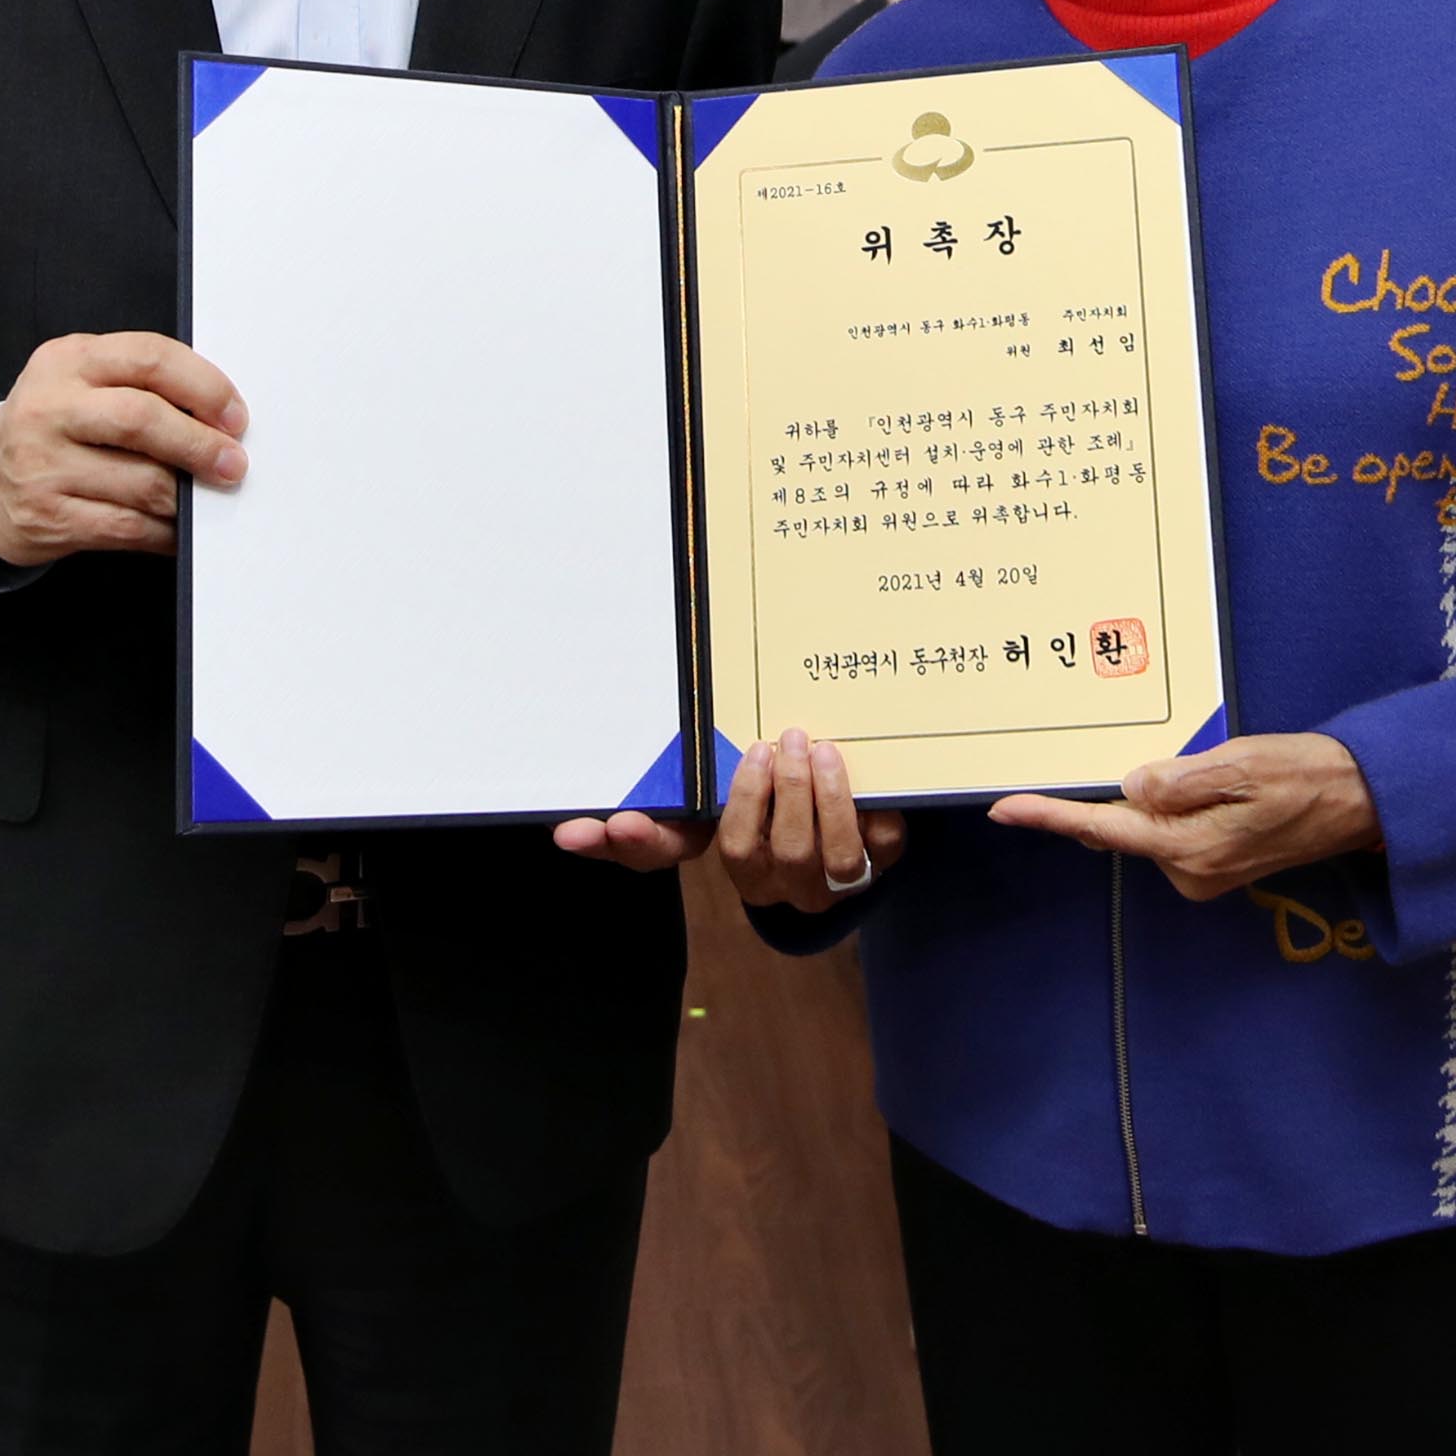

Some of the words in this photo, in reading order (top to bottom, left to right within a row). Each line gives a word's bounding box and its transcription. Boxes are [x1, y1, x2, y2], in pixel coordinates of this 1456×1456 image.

[756, 181, 847, 201] 제2021-16호
[847, 322, 912, 340] 인천광역시
[920, 319, 945, 334] 동구
[1062, 304, 1128, 322] 주민자치회
[1005, 344, 1031, 359] 위원
[785, 418, 839, 441] 귀하를
[988, 405, 1027, 428] 동구
[1040, 397, 1139, 423] 주민자치회
[770, 454, 786, 475] 및
[799, 446, 910, 473] 주민자치센터
[1036, 434, 1076, 457] 관한
[1256, 424, 1338, 485] Be
[870, 476, 933, 500] 규정에
[952, 473, 994, 495] 따라
[773, 513, 868, 539] 주민자치회
[881, 509, 960, 532] 위원으로
[971, 500, 1079, 526] 위촉합니다.
[878, 569, 942, 593] 2021년
[955, 567, 985, 589] 4월
[997, 564, 1040, 586] 20일
[802, 646, 899, 682] 인천광역시
[909, 642, 989, 677] 동구청장
